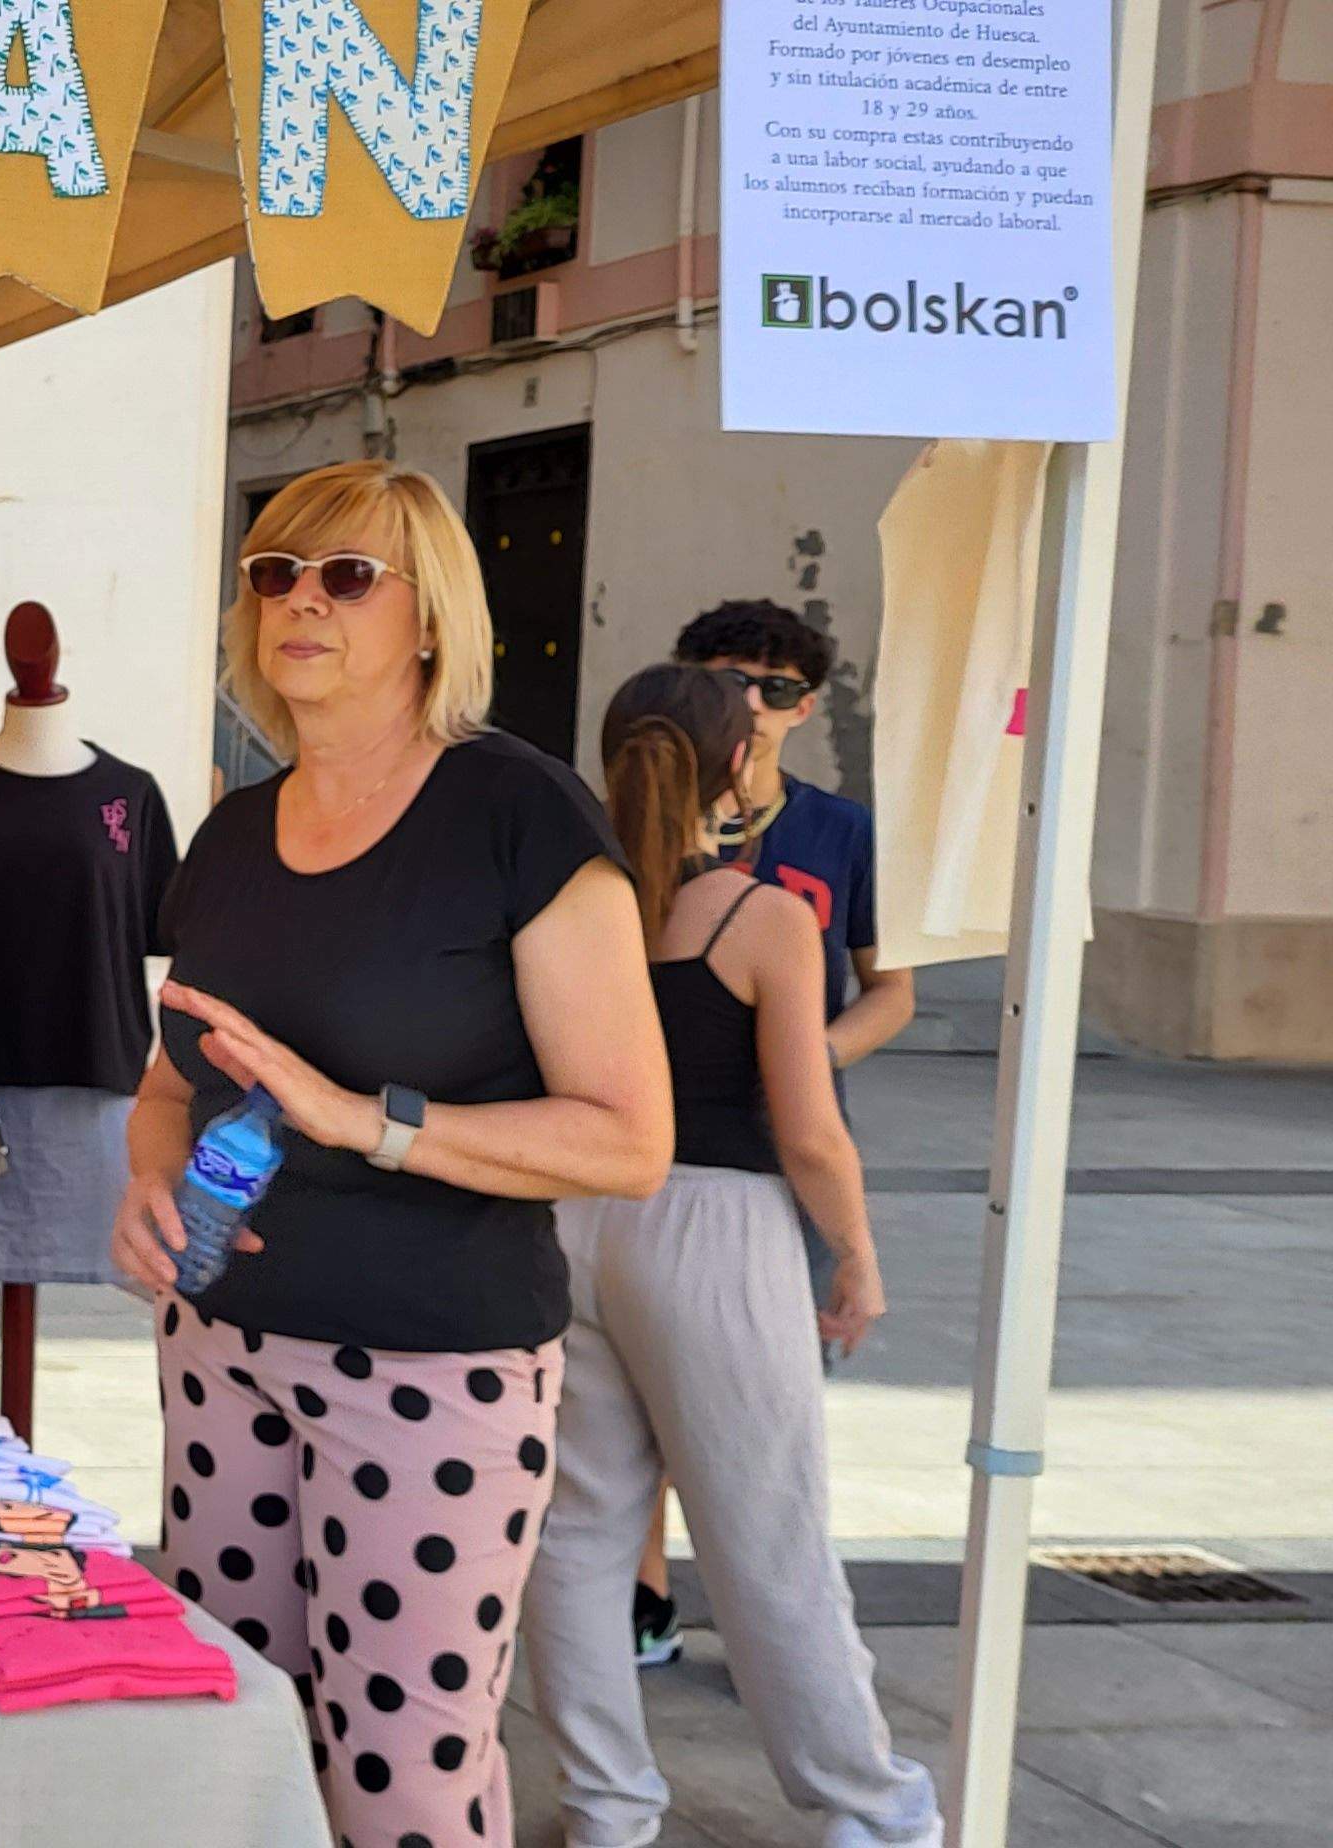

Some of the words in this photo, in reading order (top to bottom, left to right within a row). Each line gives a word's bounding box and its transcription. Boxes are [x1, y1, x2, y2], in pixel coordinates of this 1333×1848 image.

[923, 0, 1045, 17] Ocupacionales
[793, 15, 818, 31] del
[824, 17, 944, 39] Ayuntamiento
[950, 23, 970, 40] de
[976, 24, 1041, 43] Huesca.
[768, 40, 846, 60] Formado
[851, 48, 881, 65] por
[885, 47, 950, 66] jóvenes
[956, 55, 975, 67] en
[981, 52, 1071, 74] desempleo
[769, 71, 781, 88] y
[787, 69, 812, 86] sin
[818, 71, 899, 90] titulación
[904, 75, 992, 95] académica
[998, 80, 1018, 96] de
[1024, 83, 1069, 98] entre
[863, 100, 884, 115] 18
[889, 105, 900, 120] y
[906, 102, 929, 117] 29
[935, 104, 979, 120] años.
[765, 120, 802, 139] Con
[808, 128, 826, 139] su
[833, 129, 897, 146] compra
[903, 132, 944, 146] estas
[949, 132, 1073, 153] contribuyendo
[771, 152, 781, 164] a
[787, 152, 819, 166] una
[824, 150, 868, 168] labor
[875, 154, 927, 172] social,
[933, 157, 1015, 177] ayudando
[1021, 165, 1031, 176] a
[1036, 165, 1068, 181] que
[743, 172, 770, 190] los
[775, 175, 847, 194] alumnos
[853, 179, 916, 198] reciban
[922, 181, 1010, 202] formación
[1016, 190, 1027, 207] y
[1032, 188, 1094, 207] puedan
[783, 202, 894, 226] incorporarse
[899, 207, 913, 225] al
[919, 211, 994, 228] mercado
[999, 212, 1061, 232] laboral.
